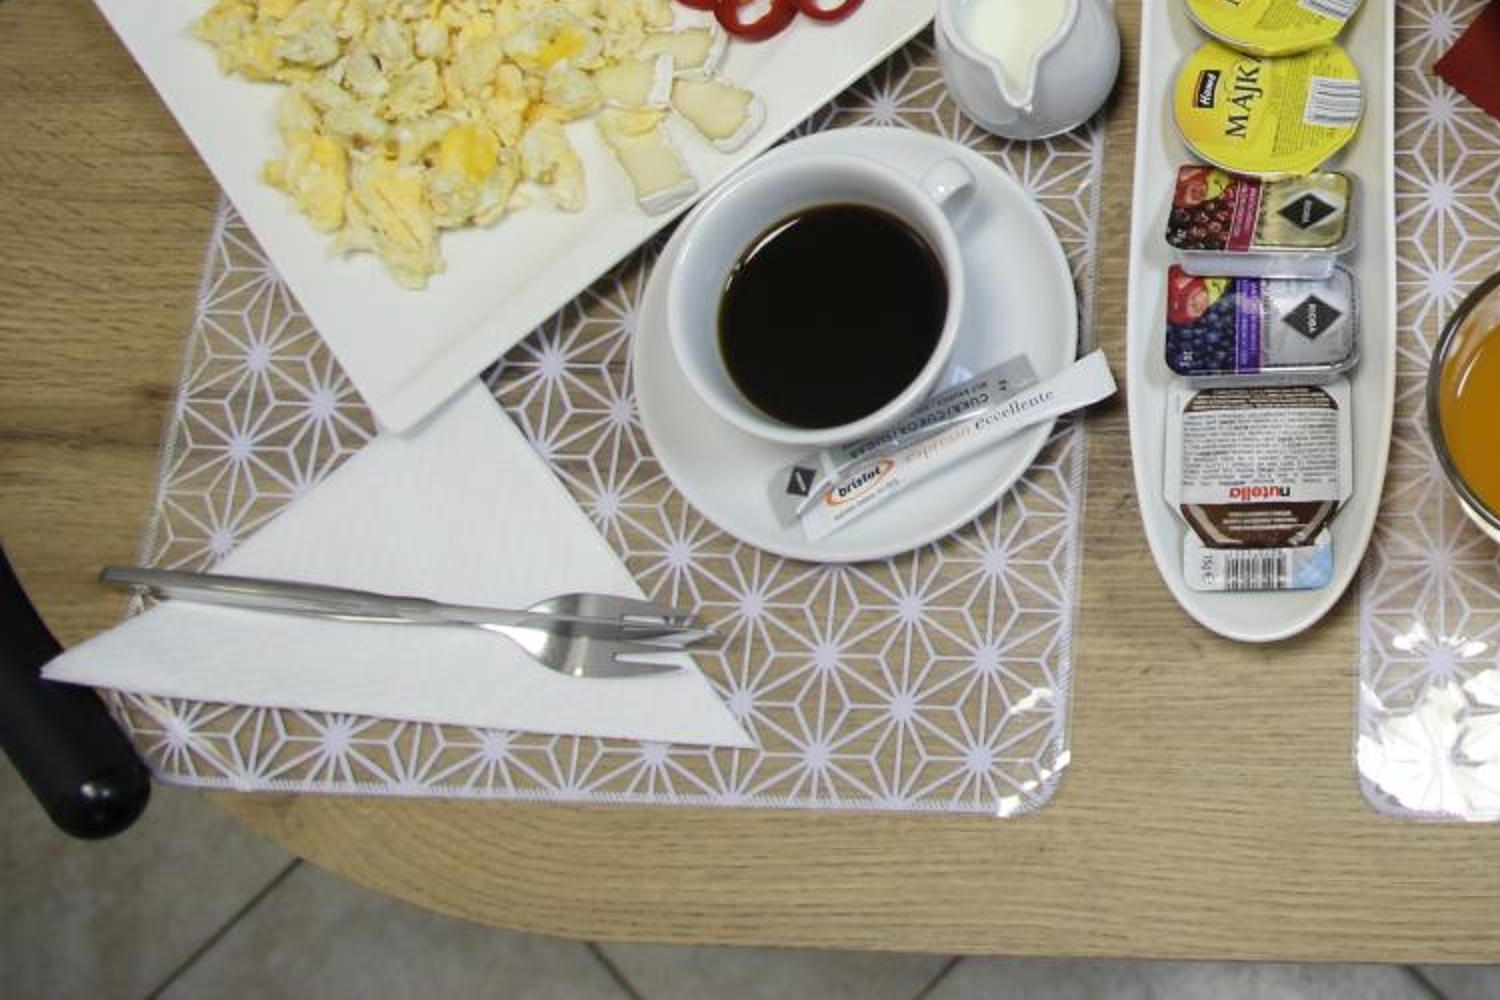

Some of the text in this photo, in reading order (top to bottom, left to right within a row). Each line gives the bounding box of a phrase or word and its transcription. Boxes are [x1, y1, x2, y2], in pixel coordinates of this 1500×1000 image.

[1224, 57, 1263, 139] MÁJK
[837, 465, 883, 498] bristot
[1229, 484, 1291, 500] nutella
